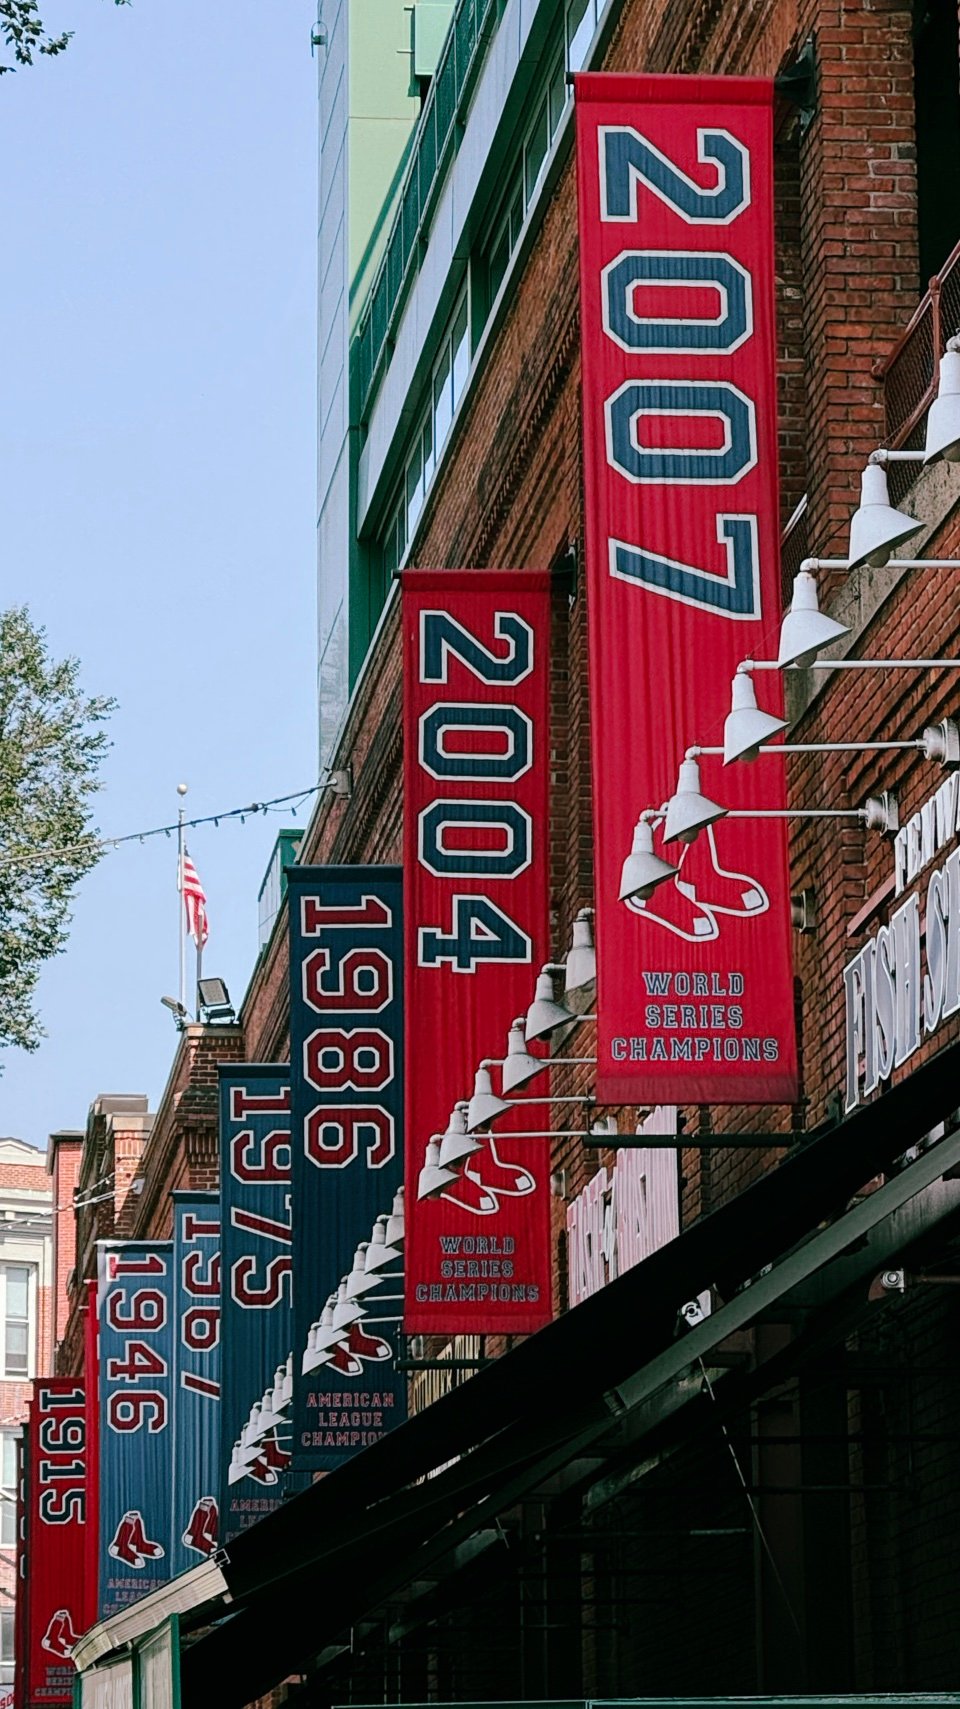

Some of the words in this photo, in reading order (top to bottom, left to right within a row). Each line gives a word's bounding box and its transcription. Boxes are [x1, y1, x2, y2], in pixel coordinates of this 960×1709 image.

[597, 125, 762, 621] 2007
[418, 609, 534, 974] 2004
[894, 769, 960, 897] FENW
[642, 971, 745, 997] WORLD
[644, 1004, 743, 1030] SERIES
[843, 891, 921, 1114] FISH
[300, 895, 395, 1169] 1986
[611, 1037, 780, 1063] CHAMPIONS
[229, 1086, 293, 1310] 1975
[439, 1236, 515, 1255] WORLD
[440, 1260, 514, 1279] SERIES
[415, 1285, 540, 1303] CHAMPIONS
[106, 1253, 168, 1435] 1946
[306, 1392, 395, 1408] AMERICAN
[318, 1411, 384, 1427] LEAGUE
[39, 1388, 86, 1525] 1915
